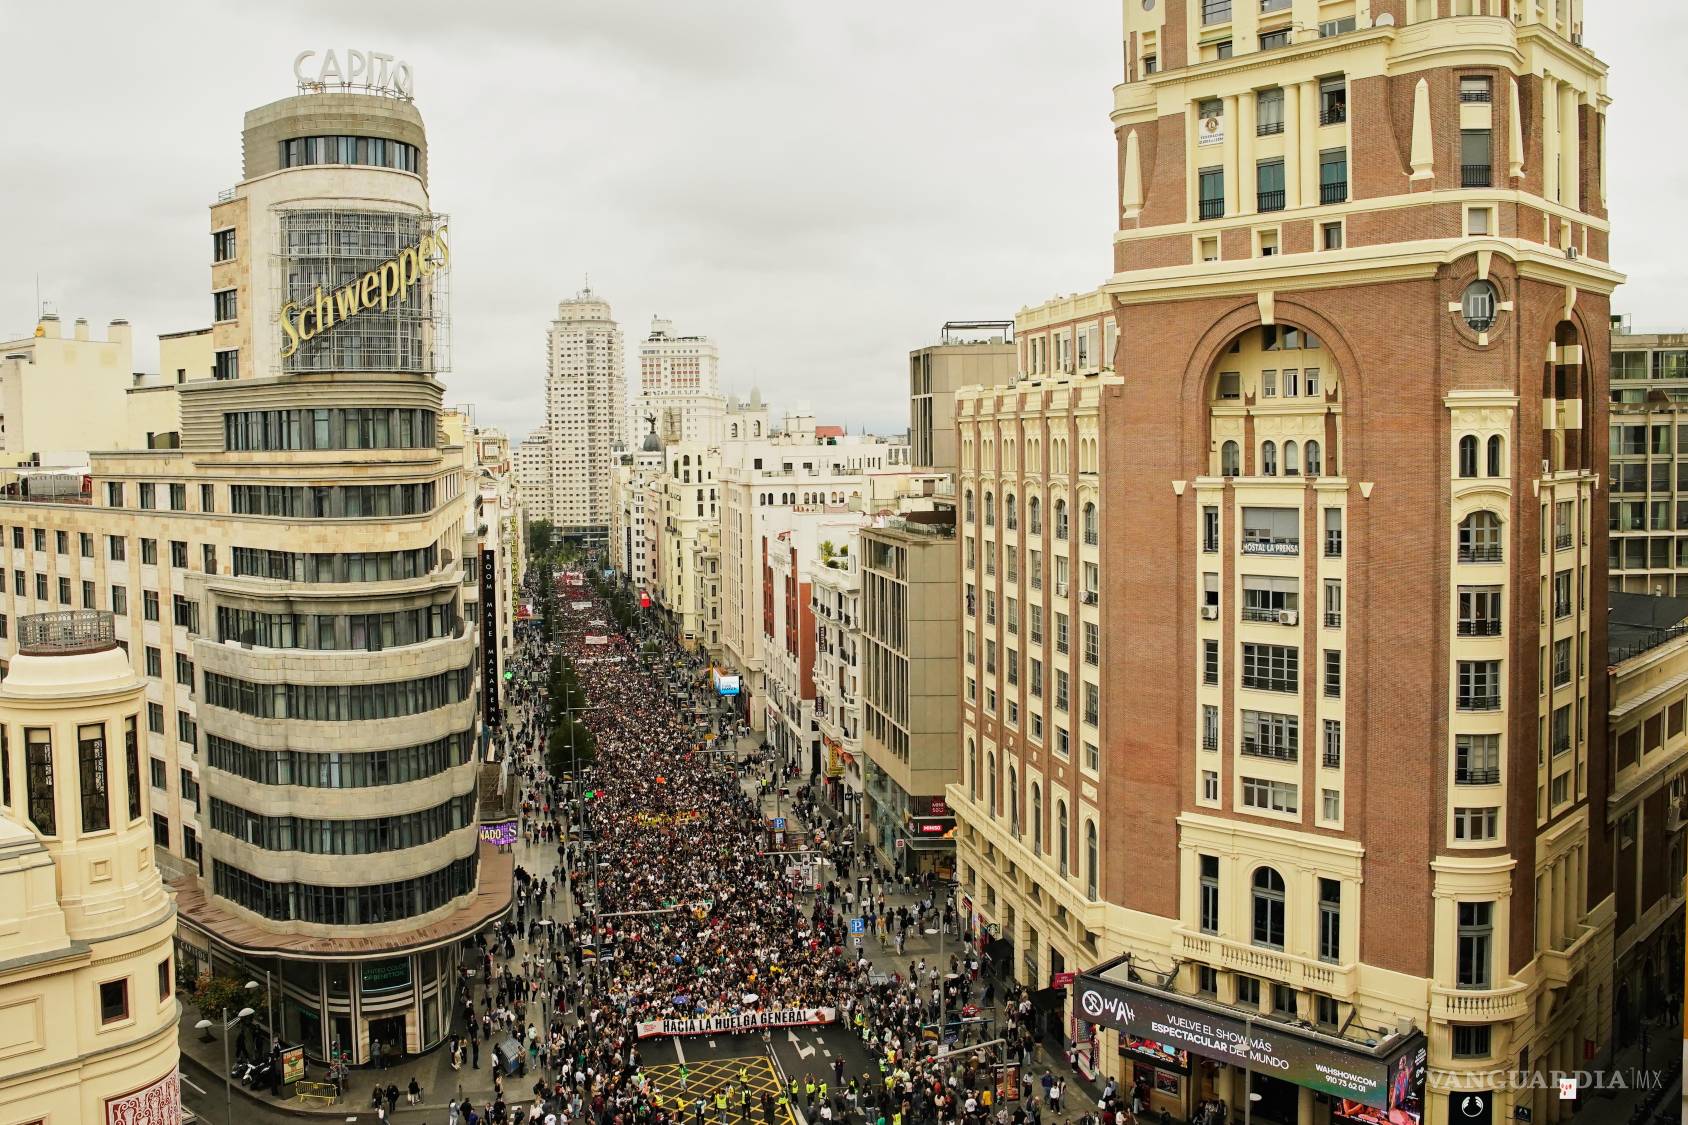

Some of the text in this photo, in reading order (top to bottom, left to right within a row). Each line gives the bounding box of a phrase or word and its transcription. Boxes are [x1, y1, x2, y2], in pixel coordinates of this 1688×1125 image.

[279, 224, 449, 357] Schweppes
[1243, 543, 1298, 553] HOSTAL LA PRENSA
[485, 553, 493, 590] ROOM
[488, 649, 496, 722] MACARENA
[663, 1019, 696, 1032] HACIA
[699, 1019, 712, 1030] LA
[715, 1014, 758, 1028] HUELGA
[760, 1010, 809, 1023] GENERAL
[1104, 998, 1136, 1025] WAH
[1151, 1021, 1290, 1070] ESPECTACULAR DEL MUNDO
[1167, 1014, 1272, 1053] VUELVE EL SHOW MÁS
[1315, 1063, 1377, 1088] WAHSHOW.COM
[1325, 1074, 1366, 1093] 910 73 62 01
